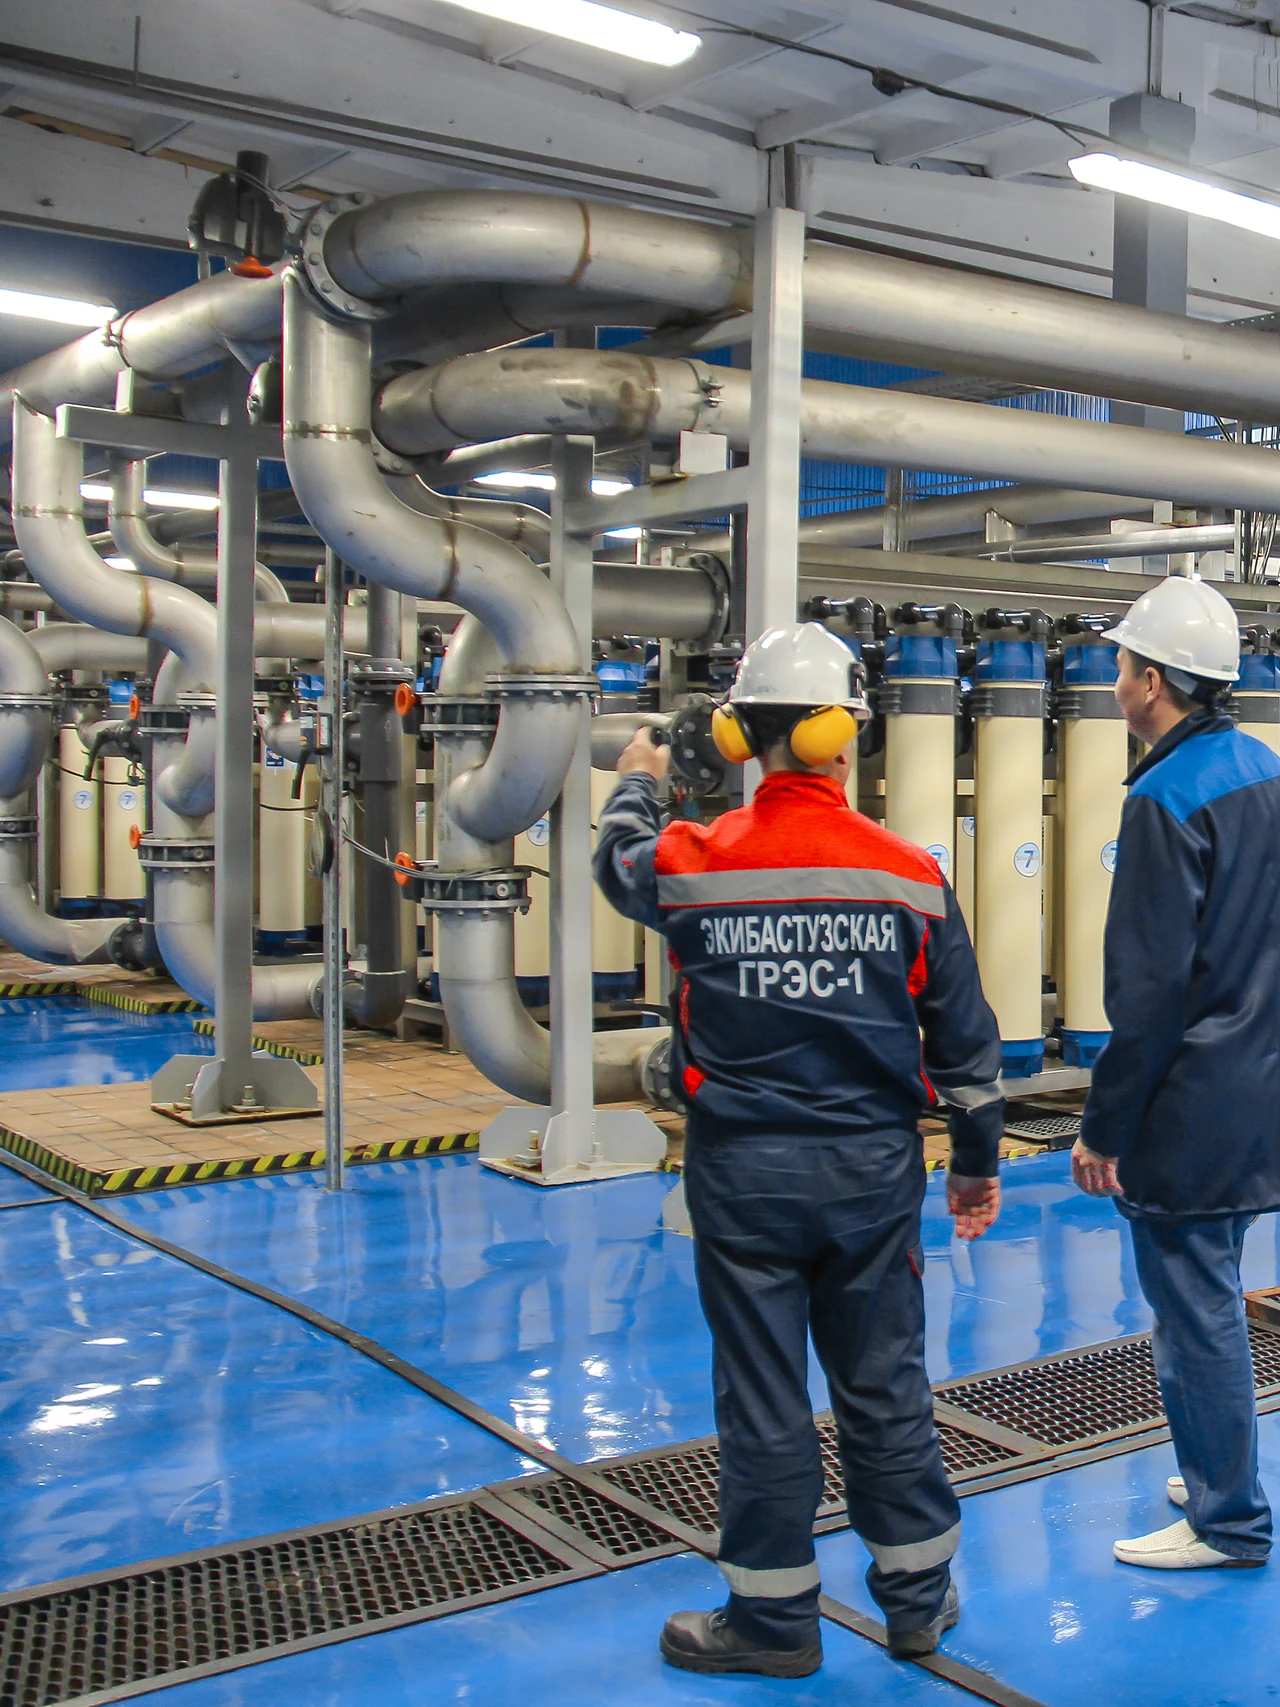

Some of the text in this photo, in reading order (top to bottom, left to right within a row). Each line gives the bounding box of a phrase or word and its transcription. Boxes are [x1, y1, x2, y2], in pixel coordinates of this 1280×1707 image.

[1024, 850, 1035, 868] 7
[700, 913, 897, 955] ЭКИБАСТУЗСКАЯ
[738, 958, 865, 999] ГРЭС-1
